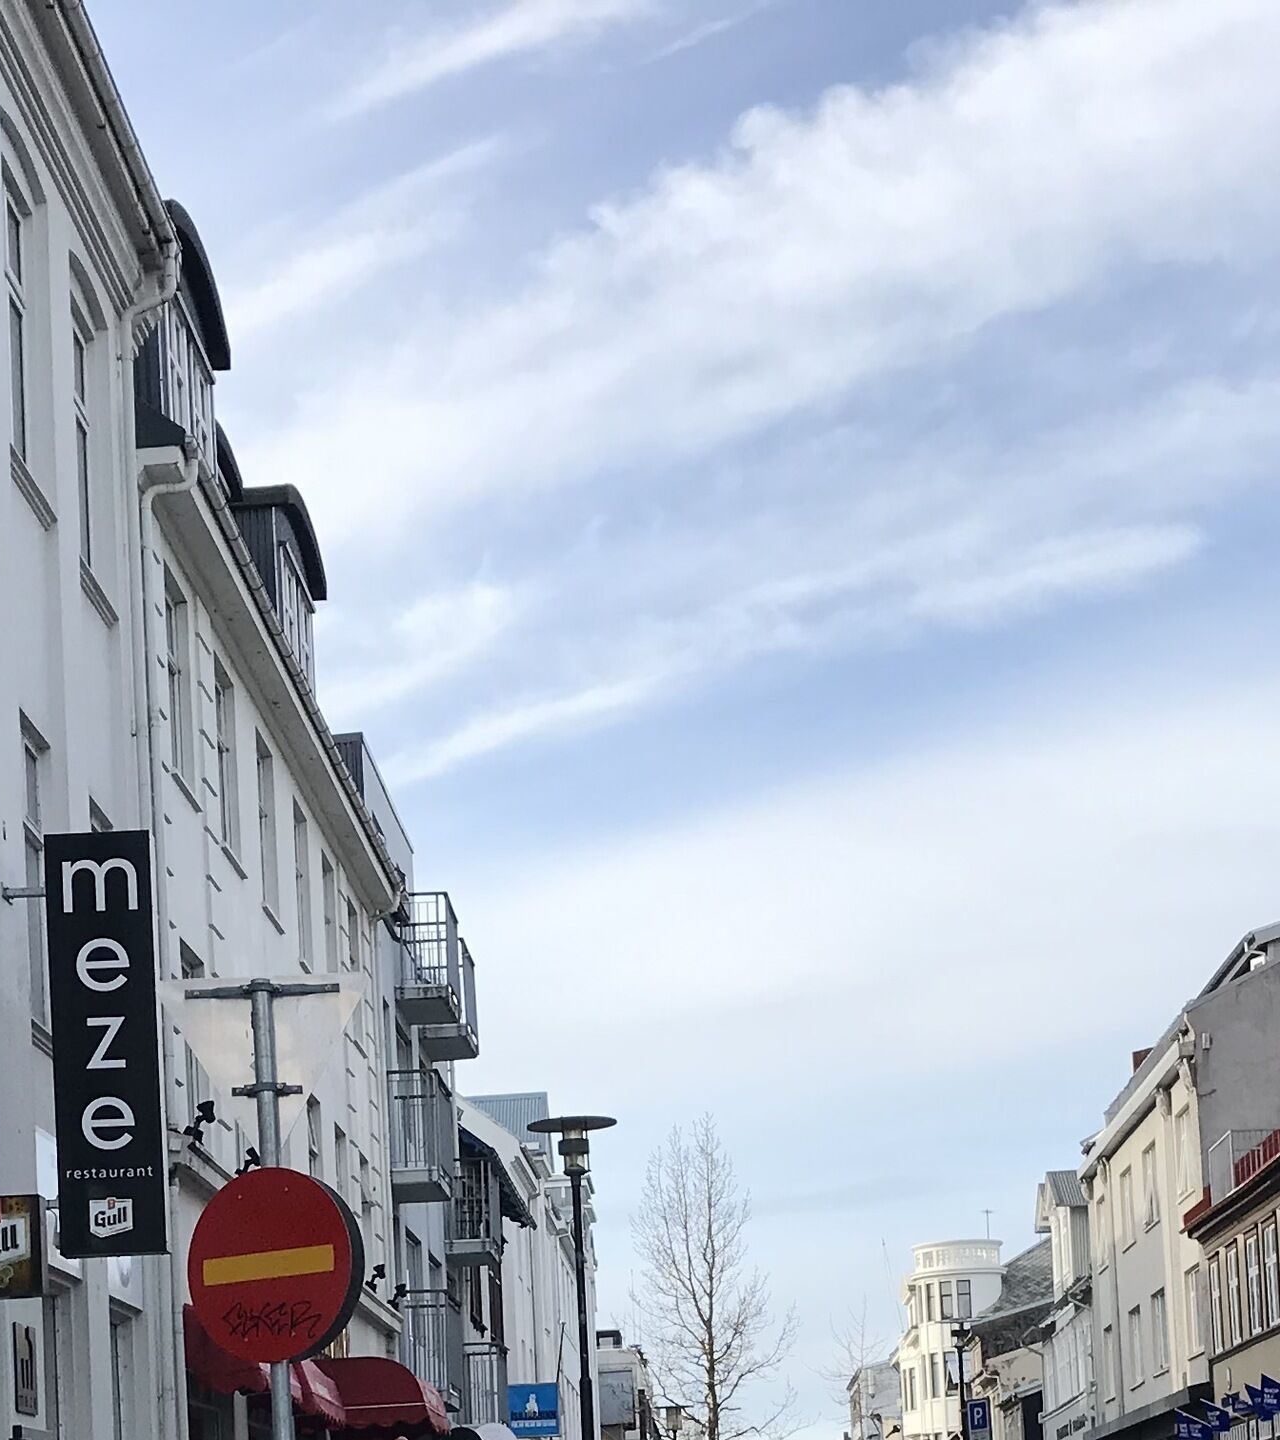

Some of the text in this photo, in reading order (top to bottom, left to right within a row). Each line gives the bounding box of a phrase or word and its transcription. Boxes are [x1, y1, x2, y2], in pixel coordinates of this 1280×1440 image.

[61, 858, 138, 1150] meze
[66, 1166, 154, 1180] restaurant
[94, 1206, 128, 1228] Gull
[974, 1407, 983, 1425] P
